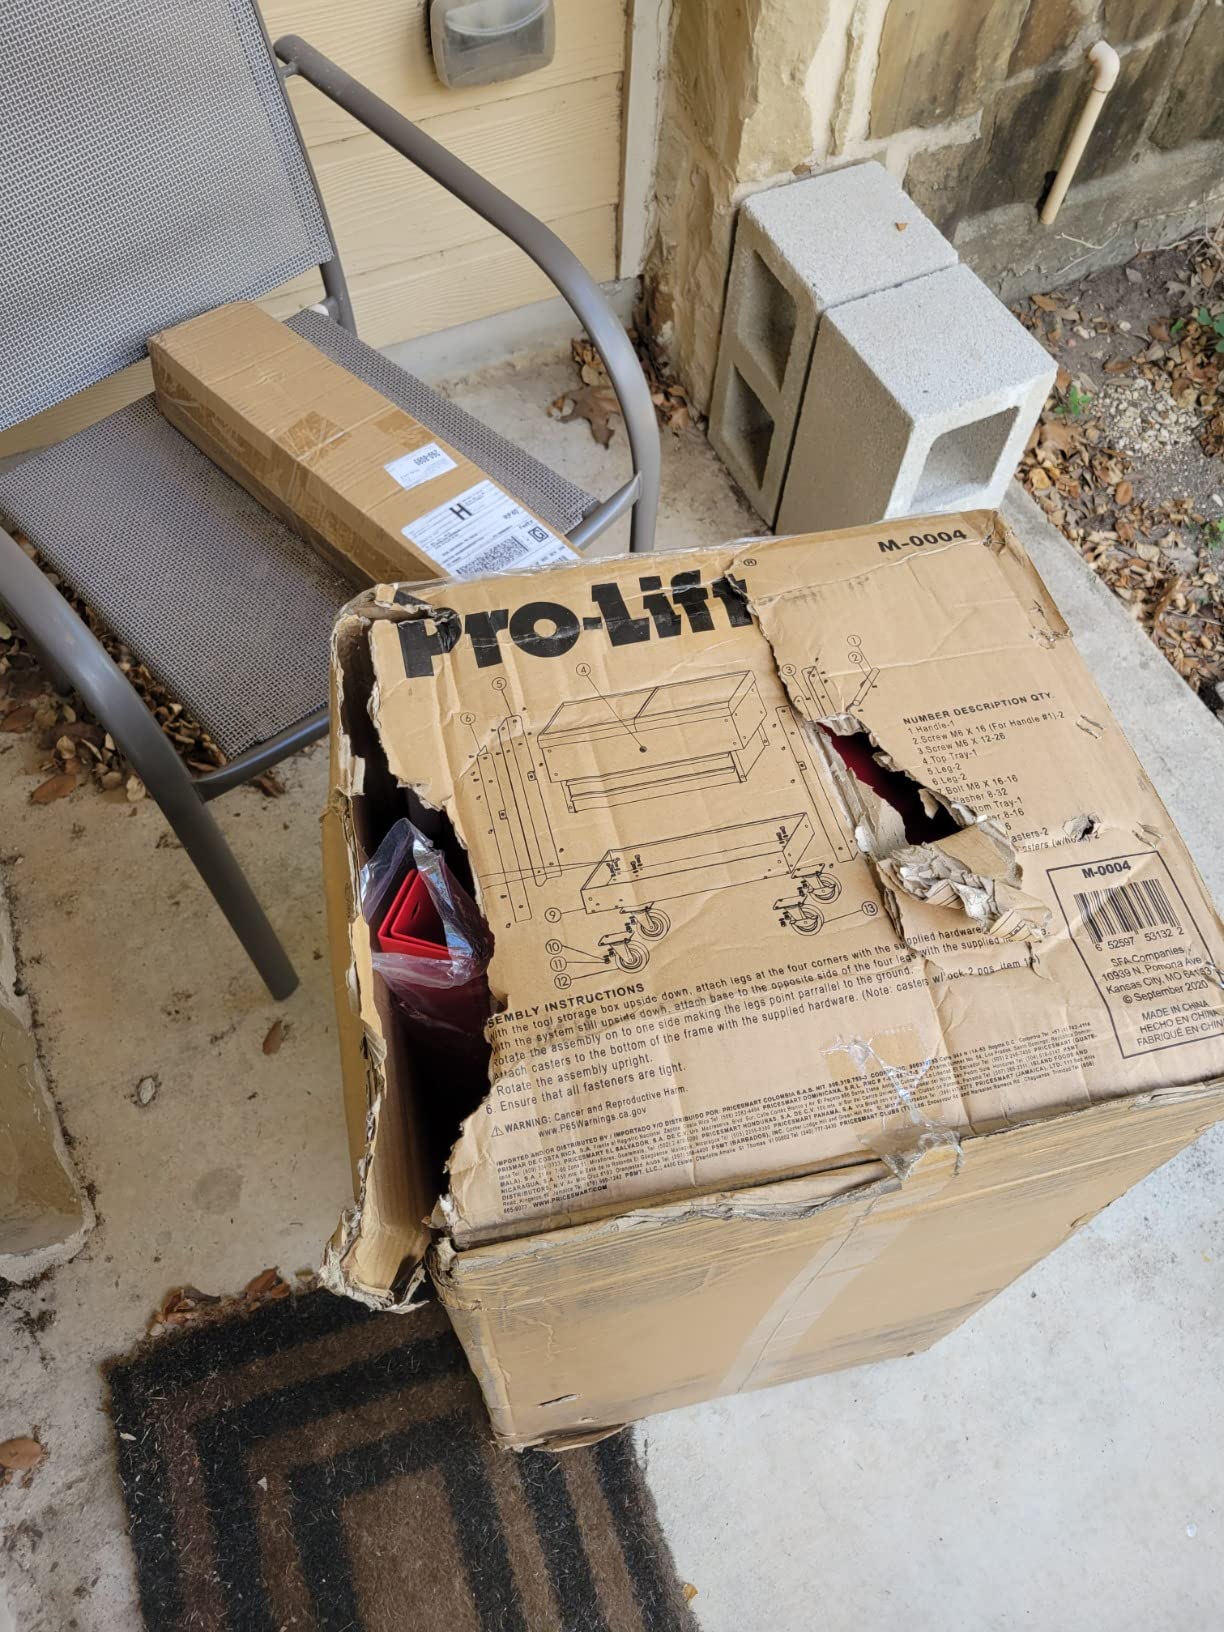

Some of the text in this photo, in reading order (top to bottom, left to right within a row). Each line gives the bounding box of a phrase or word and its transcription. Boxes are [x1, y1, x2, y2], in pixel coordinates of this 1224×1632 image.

[450, 503, 472, 520] H
[878, 529, 968, 552] M-0004
[903, 710, 950, 725] NUMBER
[954, 696, 1027, 716] DESCRIPTION
[912, 733, 948, 746] 2.Screw
[950, 730, 964, 738] M6
[975, 725, 987, 734] 16
[989, 720, 1007, 733] (For
[1010, 714, 1040, 730] Handle
[955, 739, 969, 748] M6
[980, 732, 1006, 744] 12-26
[922, 748, 978, 766] 4.Top Tray-1
[927, 764, 962, 776] 5.Leg-2
[932, 774, 967, 786] 6.Leg-2
[992, 774, 1018, 786] 16-16
[987, 788, 1008, 798] 8-32
[994, 797, 1023, 810] Tray-1
[1004, 808, 1025, 820] 8-16
[1082, 860, 1132, 879] M-0004
[1094, 926, 1184, 952] 6 52597 53132 2
[1110, 946, 1185, 968] SFA Companies
[1102, 956, 1202, 982] 10939 N. Pomona Ave
[511, 1022, 528, 1034] the
[532, 1016, 553, 1029] tool
[556, 1006, 597, 1025] storage
[600, 1001, 619, 1013] box
[622, 994, 658, 1011] upside
[660, 985, 692, 1001] down,
[695, 978, 727, 993] attach
[730, 972, 752, 987] legs
[755, 970, 766, 979] at
[768, 966, 784, 977] the
[787, 960, 807, 973] four
[810, 953, 848, 969] corners
[851, 947, 872, 960] with
[874, 943, 890, 955] the
[514, 1036, 532, 1047] the
[536, 1027, 574, 1044] system
[577, 1020, 597, 1032] still
[600, 1012, 636, 1029] upside
[639, 1004, 671, 1020] down,
[673, 996, 706, 1012] attach
[709, 990, 734, 1003] base
[737, 987, 748, 997] to
[750, 983, 767, 994] the
[770, 973, 814, 992] opposite
[816, 967, 838, 980] side
[840, 965, 851, 975] of
[853, 960, 870, 972] the
[873, 955, 893, 968] four
[896, 951, 917, 965] legs
[942, 941, 958, 952] the
[960, 933, 1000, 952] supplied
[1106, 980, 1142, 995] Kansas
[1144, 974, 1166, 988] City,
[1166, 970, 1182, 982] MO
[1134, 986, 1184, 1004] September
[1184, 980, 1208, 992] 2020
[544, 981, 645, 1013] INSTRUCTIONS
[529, 1045, 546, 1057] the
[550, 1033, 601, 1055] assembly
[604, 1029, 618, 1040] on
[621, 1025, 632, 1036] to
[635, 1021, 654, 1034] one
[657, 1015, 680, 1029] side
[683, 1006, 721, 1025] making
[724, 1002, 741, 1015] the
[743, 997, 766, 1012] legs
[768, 991, 795, 1007] point
[797, 981, 840, 1000] parrallel
[843, 978, 853, 989] to
[856, 974, 873, 986] the
[875, 965, 914, 983] ground.
[1142, 1000, 1210, 1022] MADE IN CHINA
[530, 1055, 570, 1073] casters
[574, 1052, 585, 1062] to
[588, 1046, 606, 1059] the
[609, 1038, 646, 1055] bottom
[649, 1034, 660, 1046] of
[662, 1030, 680, 1044] the
[683, 1022, 714, 1039] frame
[716, 1017, 738, 1032] with
[741, 1013, 758, 1026] the
[761, 1003, 805, 1024] supplied
[807, 991, 858, 1012] hardware.
[895, 976, 928, 992] casters
[1140, 1018, 1174, 1034] HECHO
[1176, 1015, 1191, 1026] EN
[1185, 1026, 1199, 1036] EN
[1201, 1018, 1224, 1032] CHIN
[495, 1052, 653, 1096] Rotate the assembly upright.
[485, 1059, 686, 1115] 6. Ensure that all fasteners are tight.
[504, 1083, 688, 1132] WARNING: Cancer and Reproductive Harm.
[537, 1104, 647, 1140] www.P65Warnings.ca.gov
